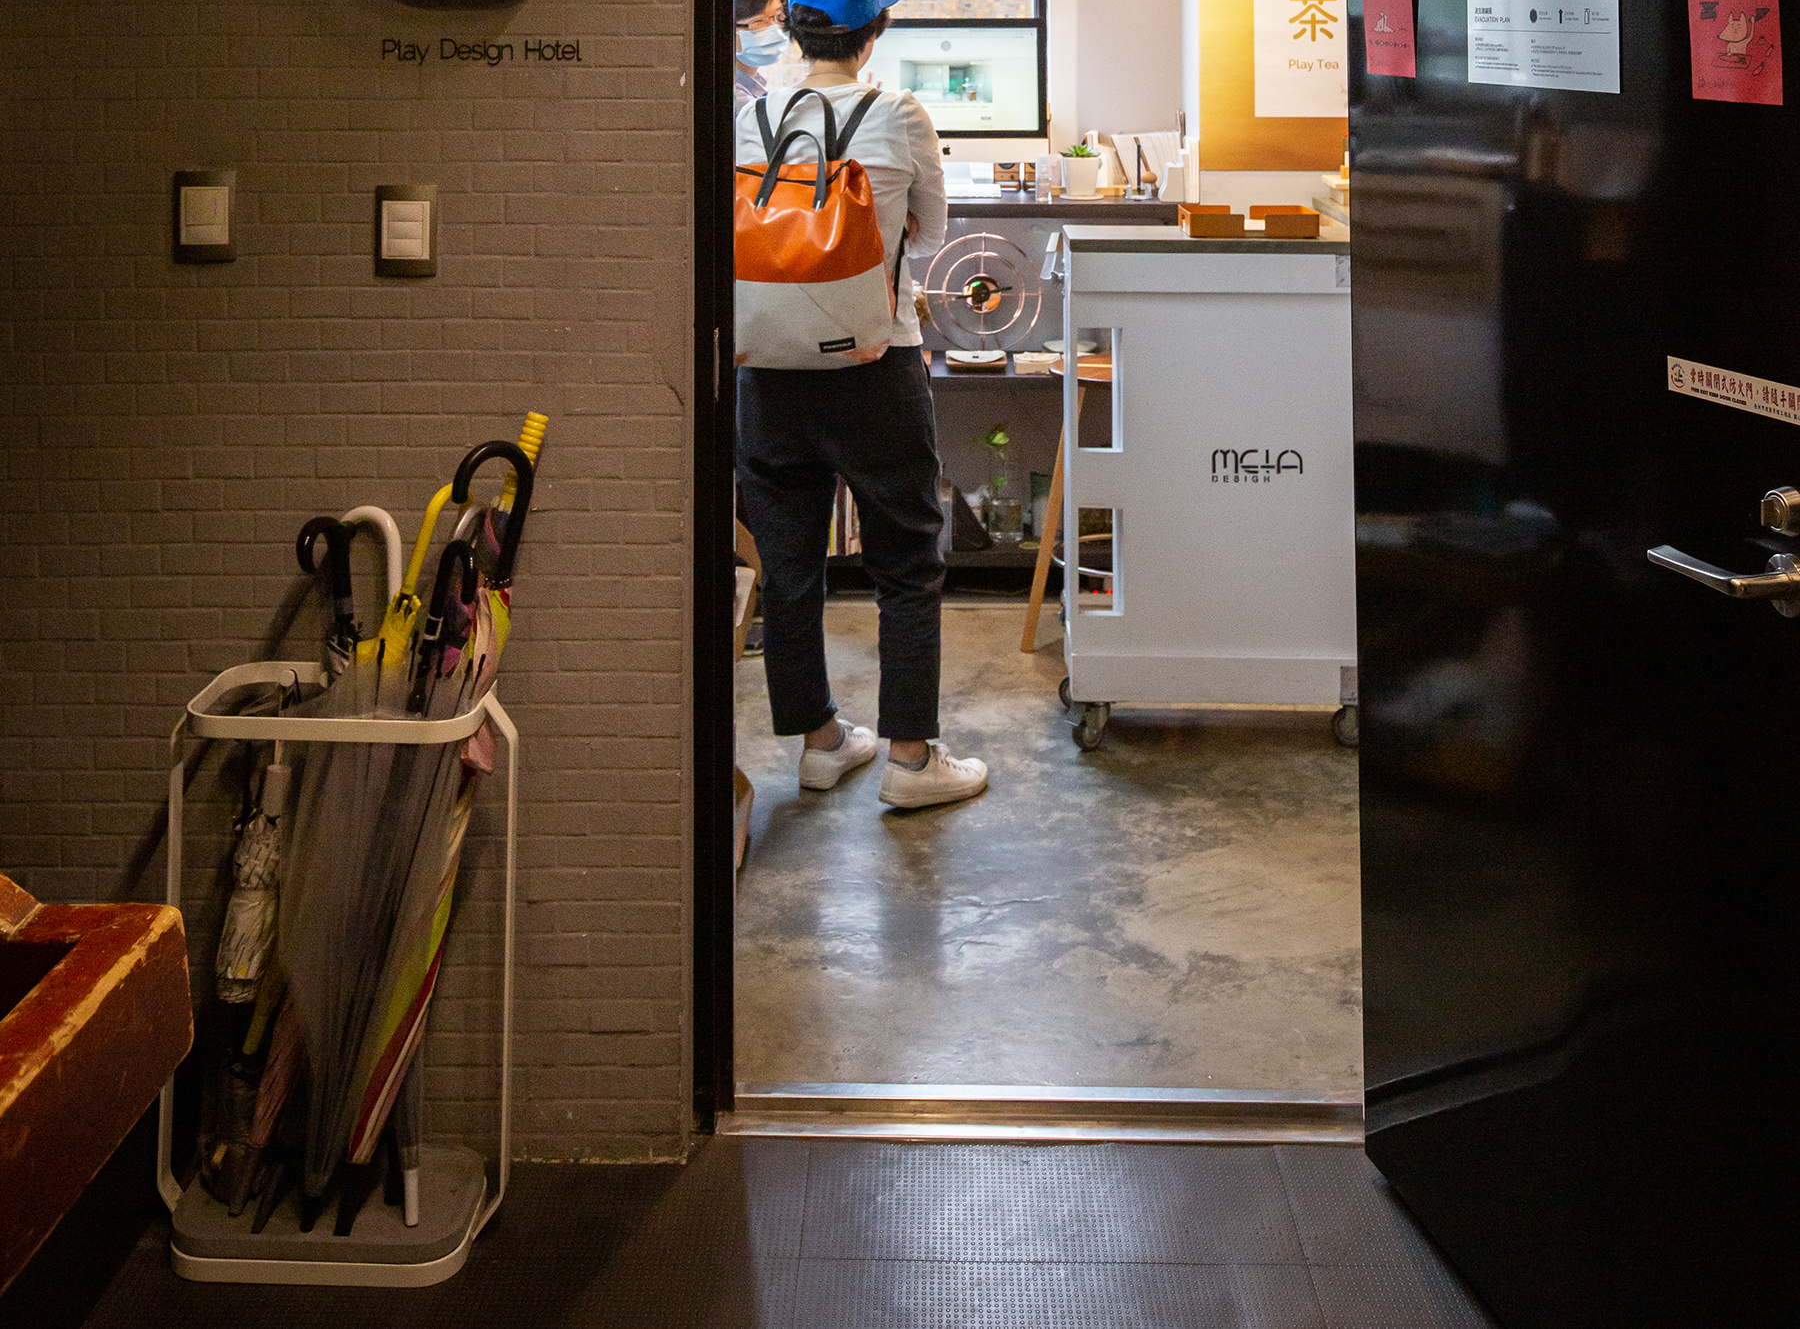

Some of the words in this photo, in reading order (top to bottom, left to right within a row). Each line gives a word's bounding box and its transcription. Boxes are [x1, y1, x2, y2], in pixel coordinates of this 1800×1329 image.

[382, 38, 431, 66] Play
[440, 38, 514, 67] Design
[525, 39, 582, 62] Hotel
[1288, 59, 1314, 72] Play
[1316, 59, 1340, 70] Tea
